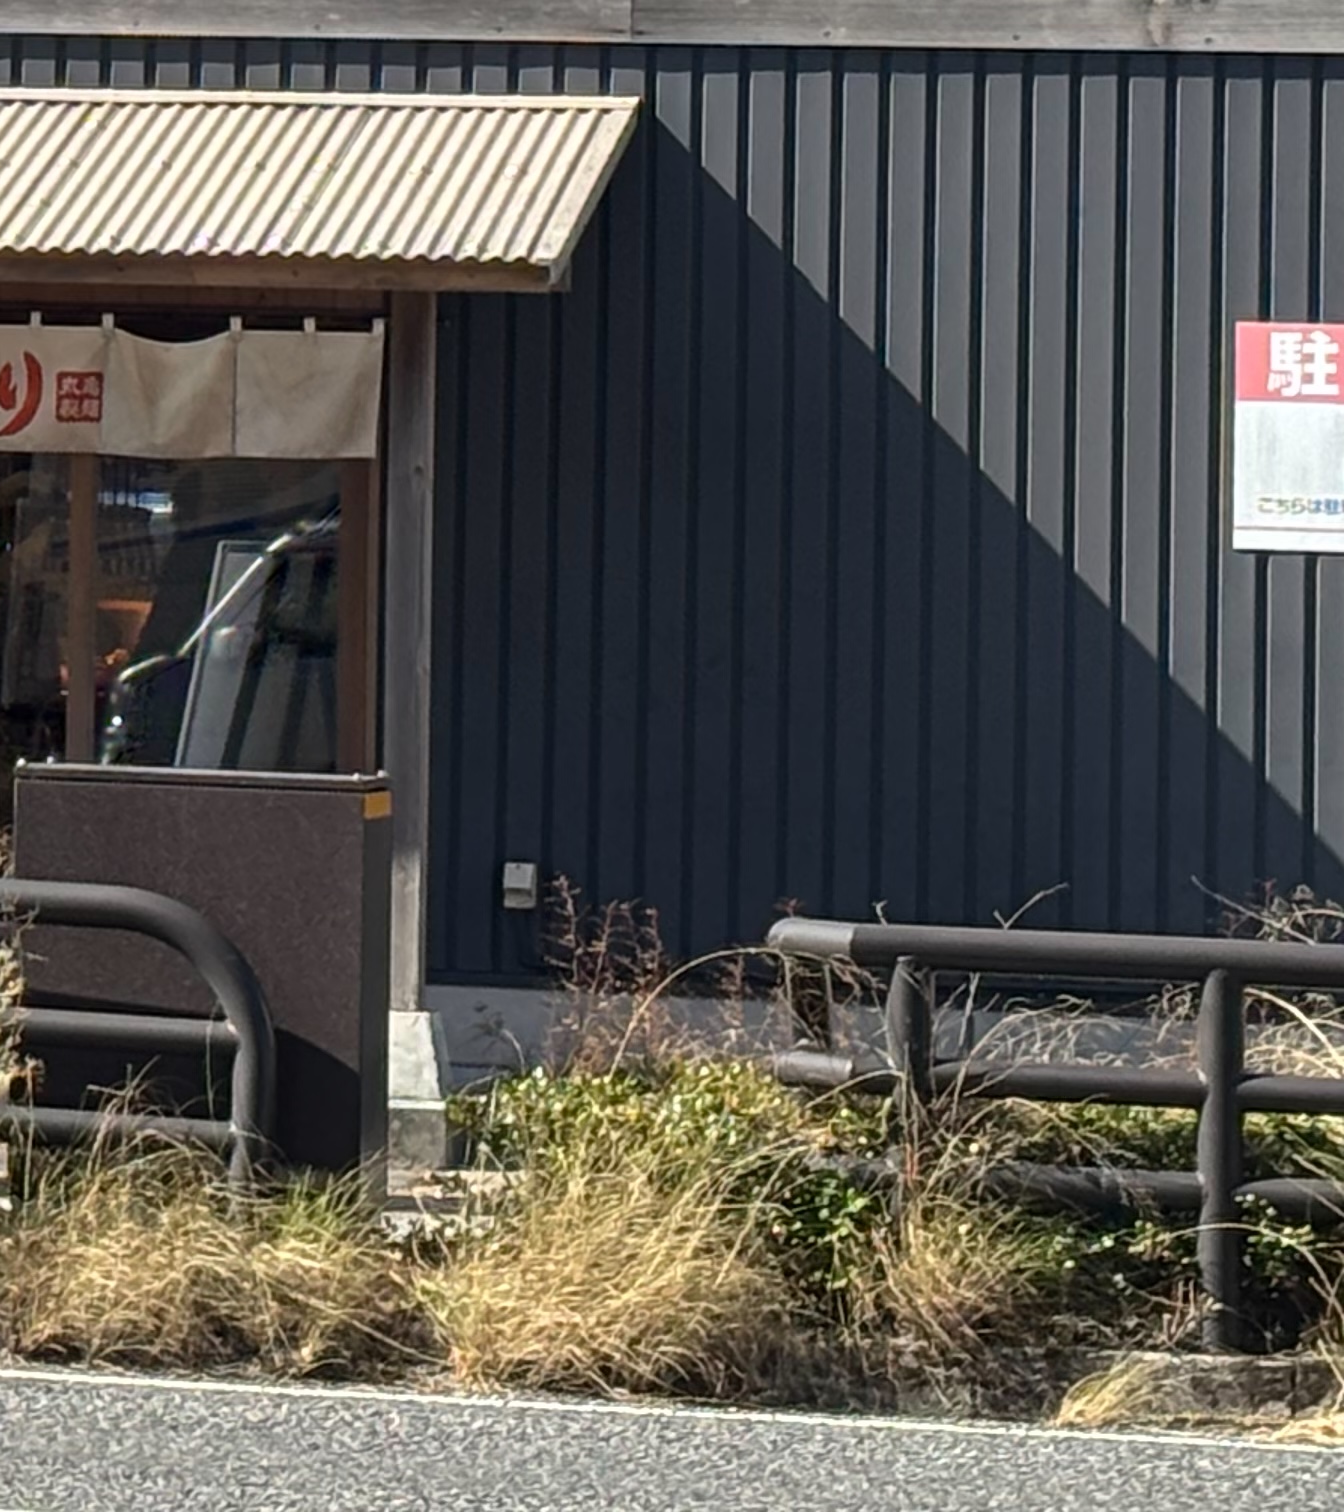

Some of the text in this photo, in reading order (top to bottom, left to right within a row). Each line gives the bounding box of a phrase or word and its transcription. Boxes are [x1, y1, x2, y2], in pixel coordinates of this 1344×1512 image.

[1257, 496, 1344, 516] こちらは駐
